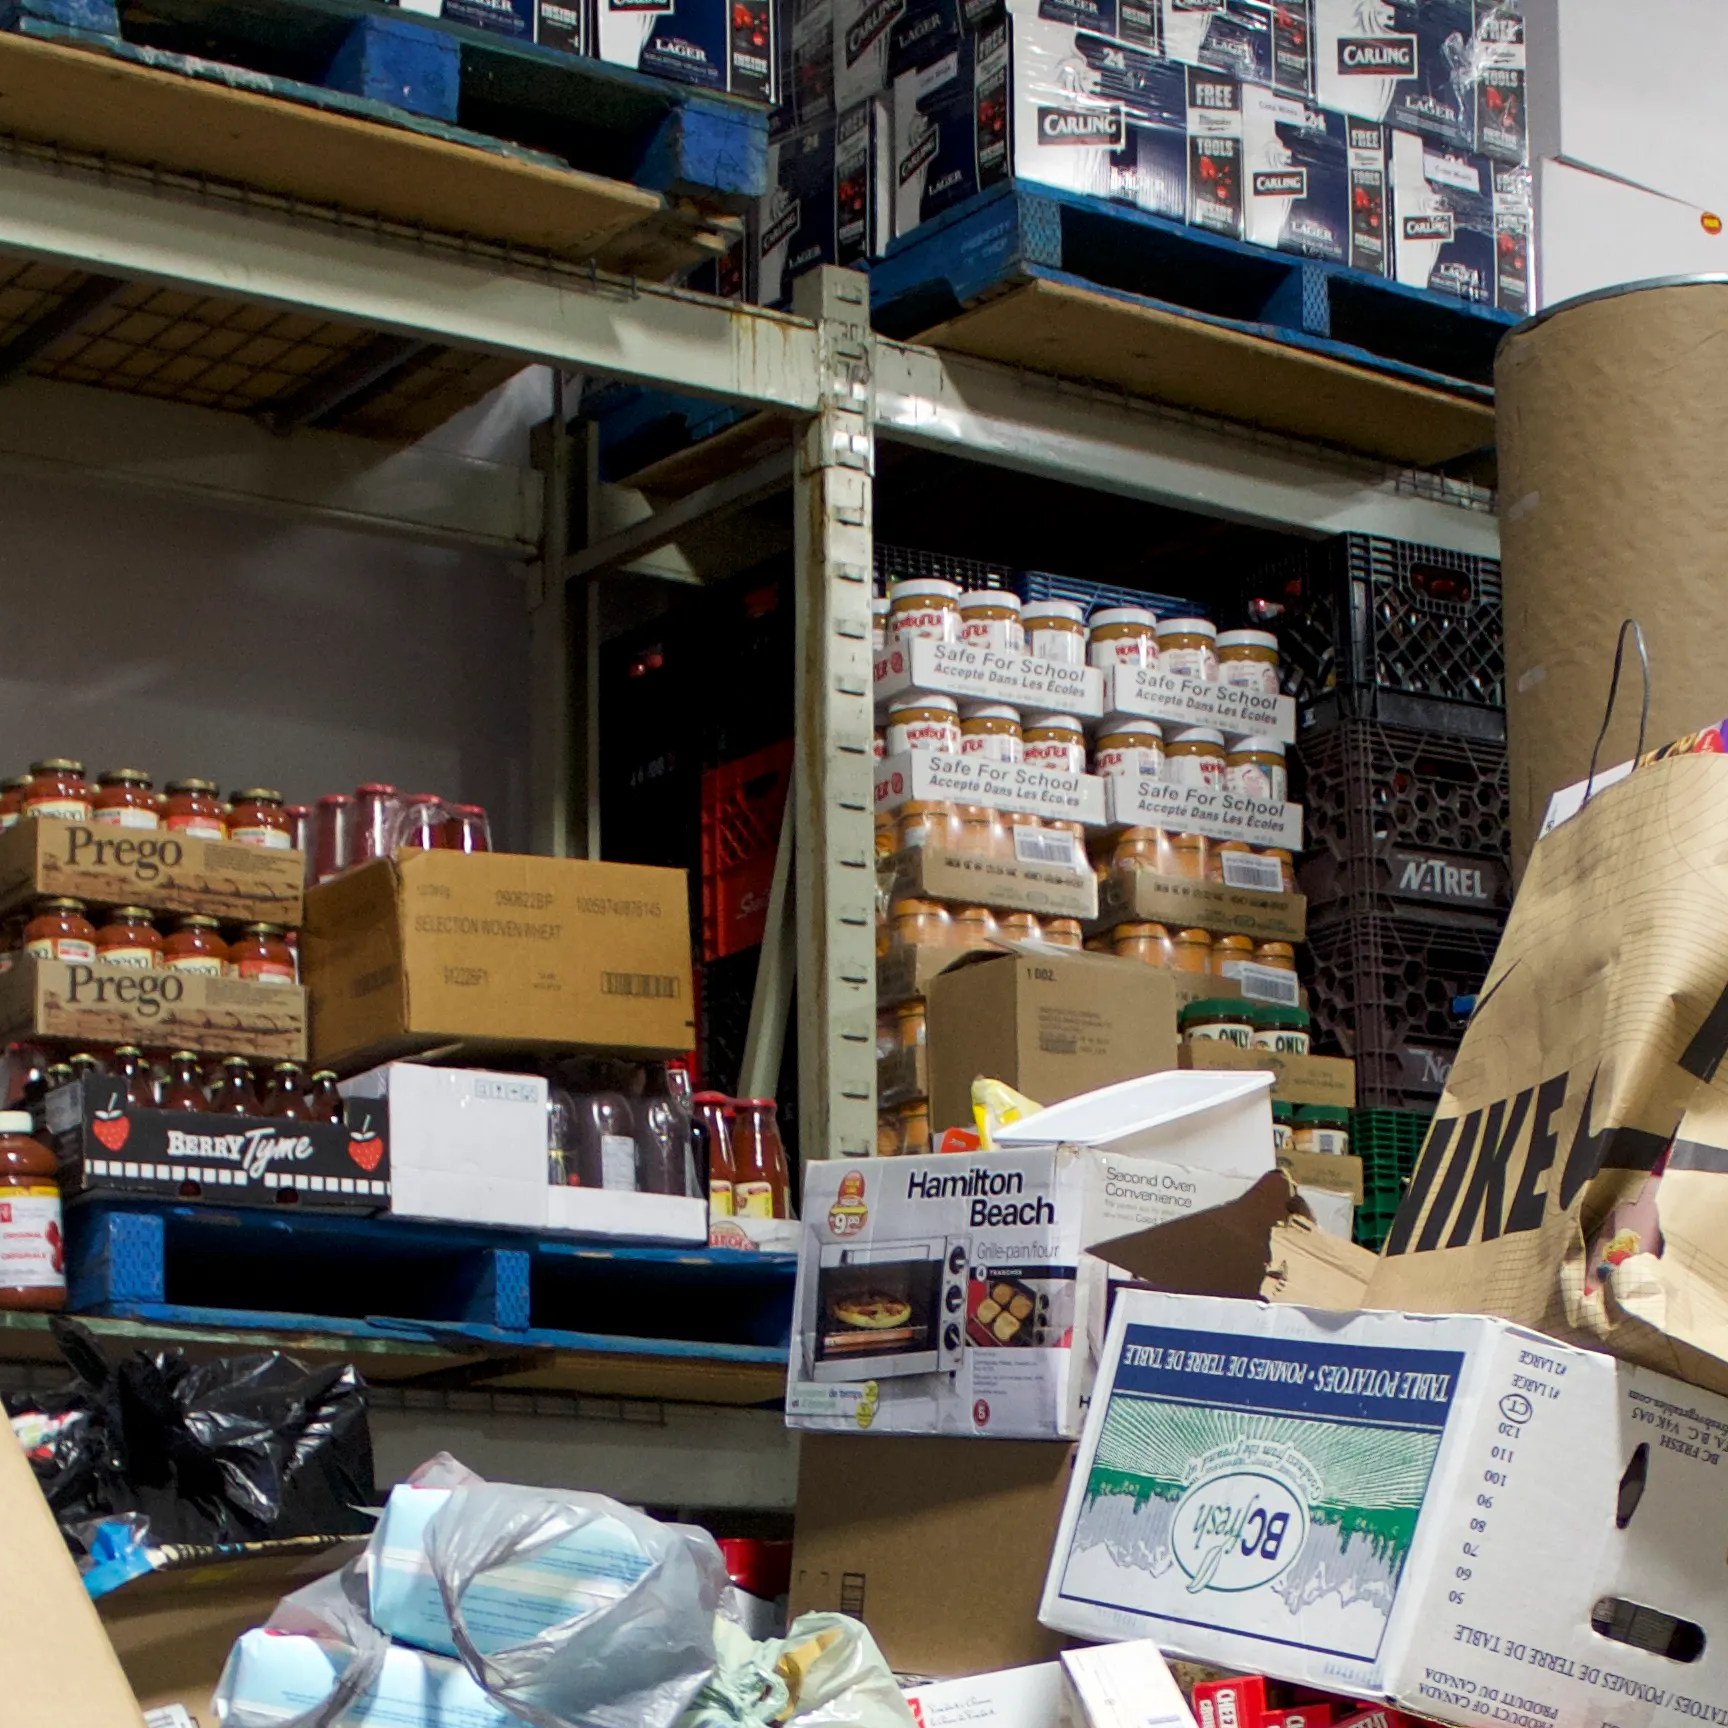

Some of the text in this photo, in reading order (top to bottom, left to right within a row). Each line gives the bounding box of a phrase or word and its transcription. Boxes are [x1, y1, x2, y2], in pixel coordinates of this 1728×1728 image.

[1343, 44, 1409, 65] CARLING
[1405, 96, 1455, 121] LAGER
[1044, 115, 1117, 137] CARLING
[1257, 175, 1302, 191] CARLING
[934, 645, 1085, 682] Safe For School
[989, 672, 1018, 686] Dans
[1022, 677, 1042, 690] Les
[1138, 782, 1284, 817] Safe For School
[1191, 807, 1219, 821] Dans
[1223, 813, 1242, 825] Les
[65, 827, 184, 881] Prego
[1401, 856, 1488, 899] NATREL
[415, 916, 563, 940] SELECTION WOVEN WHEAT
[66, 964, 184, 1017] Prego
[168, 1128, 313, 1179] BERRY Tyme
[907, 1168, 1023, 1199] Hamilton
[1106, 1167, 1196, 1193] Second Oven
[1104, 1184, 1193, 1208] Convenience
[970, 1196, 1055, 1228] Beach
[1124, 1344, 1450, 1402] TABLE POTATOES POMMES DE TERRE DE TABLE
